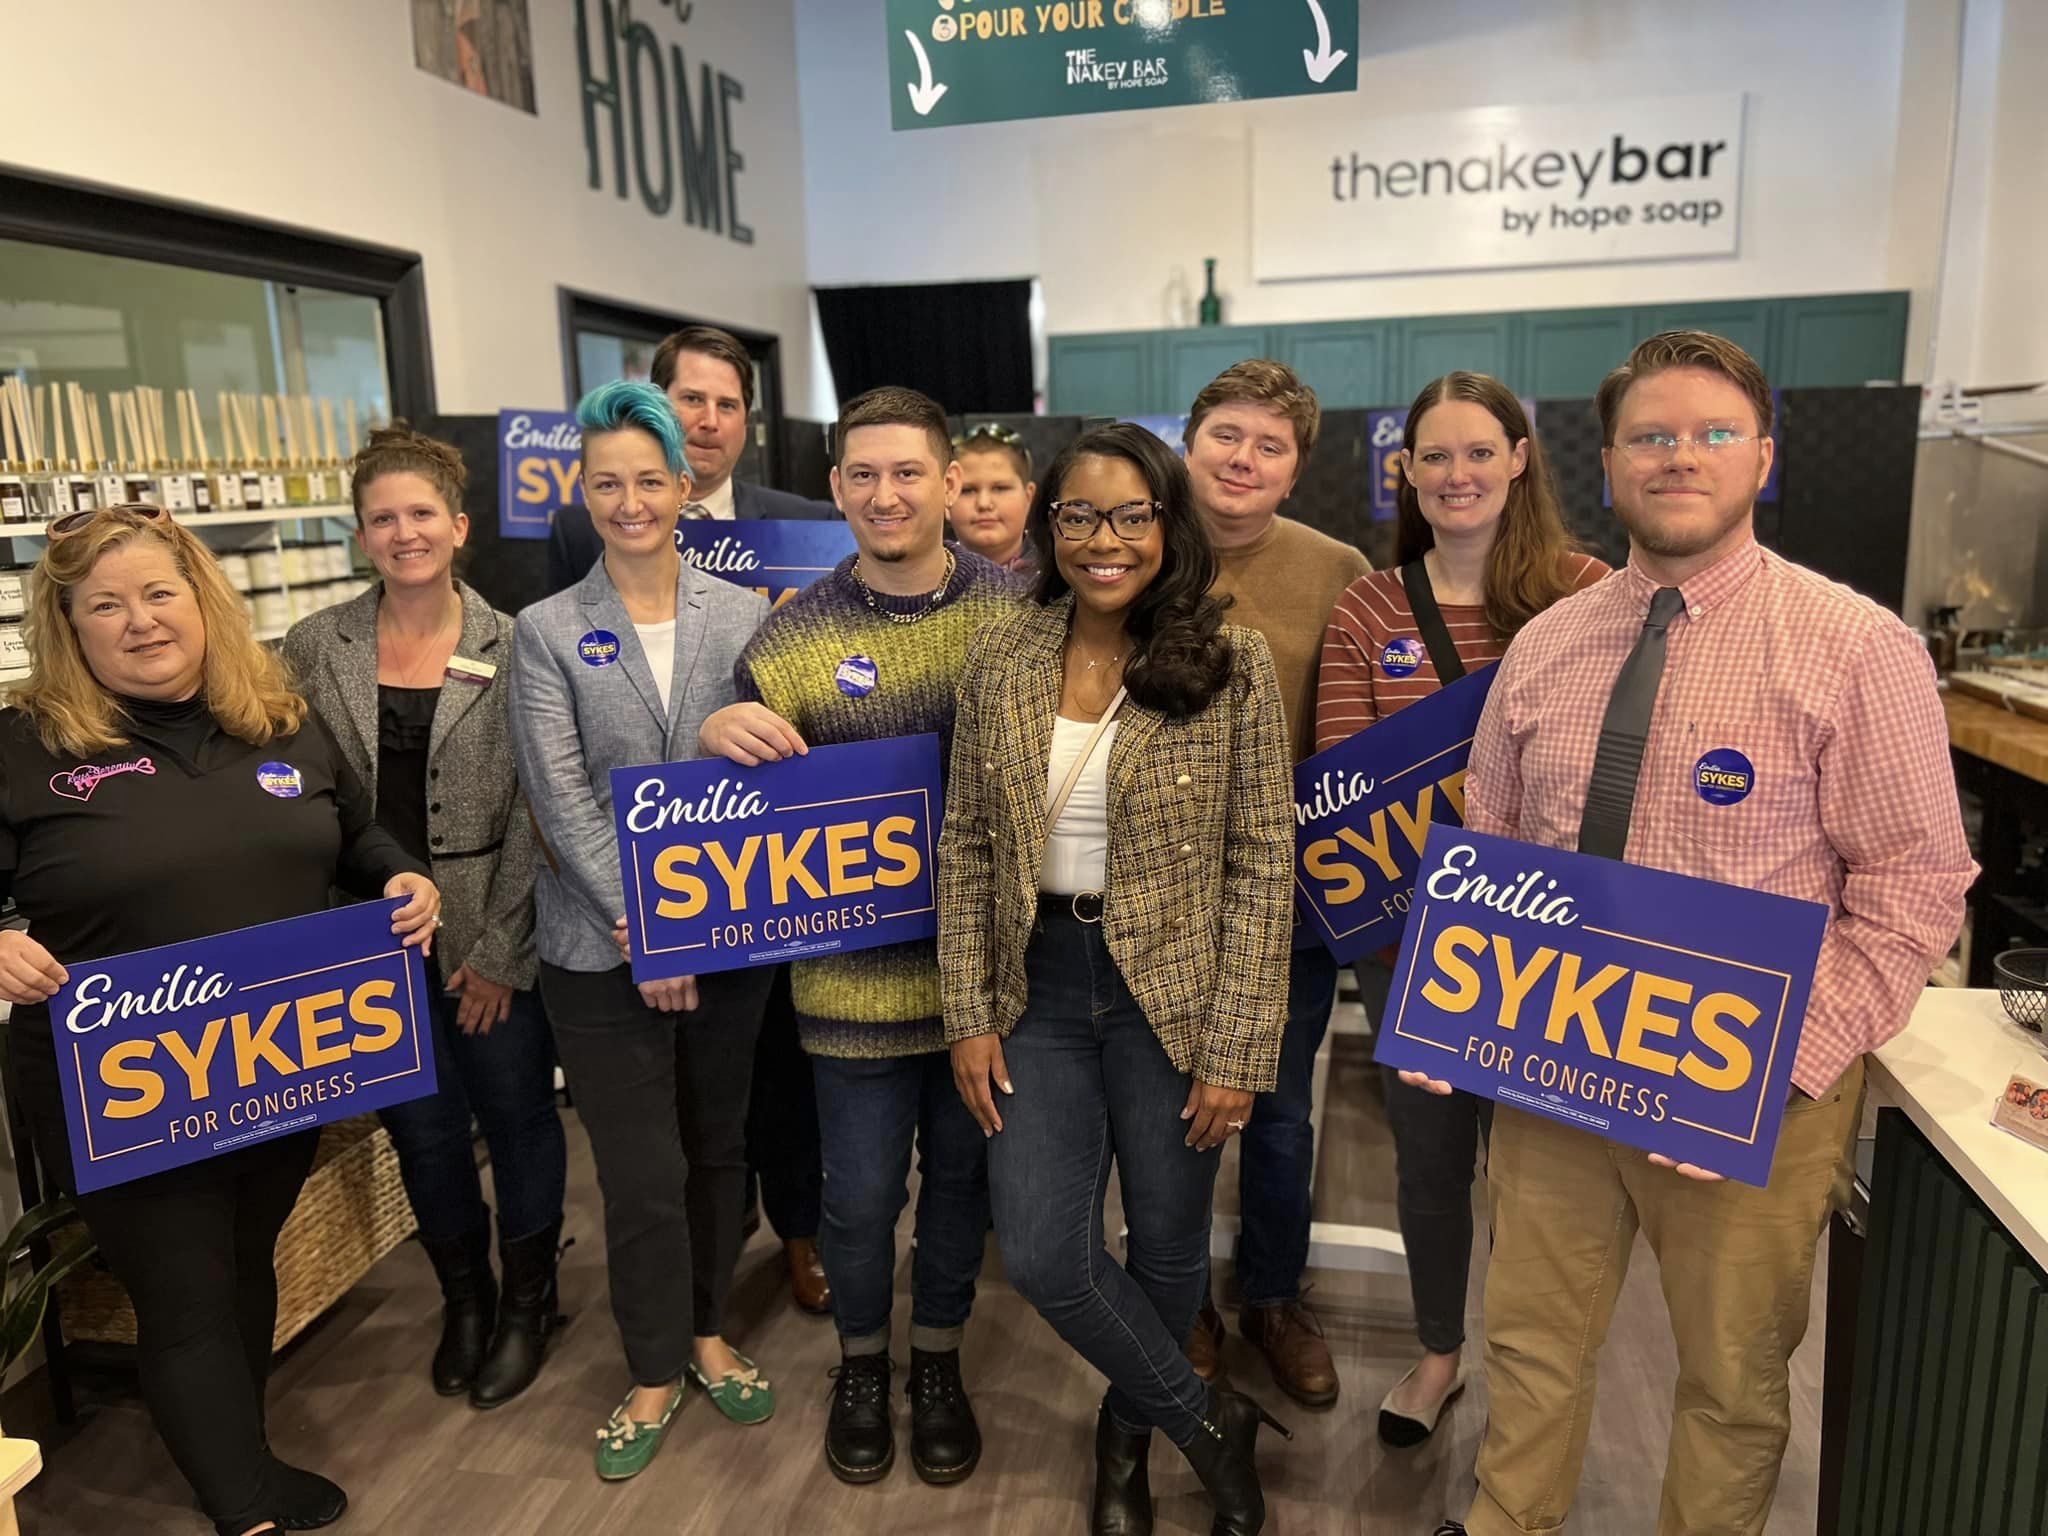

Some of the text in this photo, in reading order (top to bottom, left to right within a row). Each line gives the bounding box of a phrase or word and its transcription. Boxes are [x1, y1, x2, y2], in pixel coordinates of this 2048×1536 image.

[960, 7, 1027, 41] POUR
[1038, 1, 1104, 33] YOUR
[1113, 0, 1226, 25] CDLE
[1065, 48, 1096, 65] THE
[1066, 57, 1168, 85] NAKEY BAR
[1108, 76, 1168, 90] BY HOPE SOAP
[574, 0, 755, 246] HOME
[1502, 198, 1723, 237] by hope soap
[583, 644, 615, 656] SYKES
[1385, 653, 1417, 666] SYKES
[626, 778, 769, 833] Emilia
[1294, 770, 1375, 826] milia
[1700, 771, 1745, 788] SYKES
[1303, 768, 1467, 905] SYK
[653, 816, 921, 919] SYKES
[1426, 845, 1579, 926] Emilia
[711, 903, 877, 949] FOR CONGRESS
[65, 964, 233, 1034] Emilia
[1420, 925, 1762, 1092] SYKES
[99, 980, 403, 1119] SYKES
[169, 1110, 219, 1144] FOR
[229, 1071, 356, 1129] CONGRESS
[1464, 1036, 1514, 1075] FOR
[1523, 1054, 1670, 1124] CONGRESS
